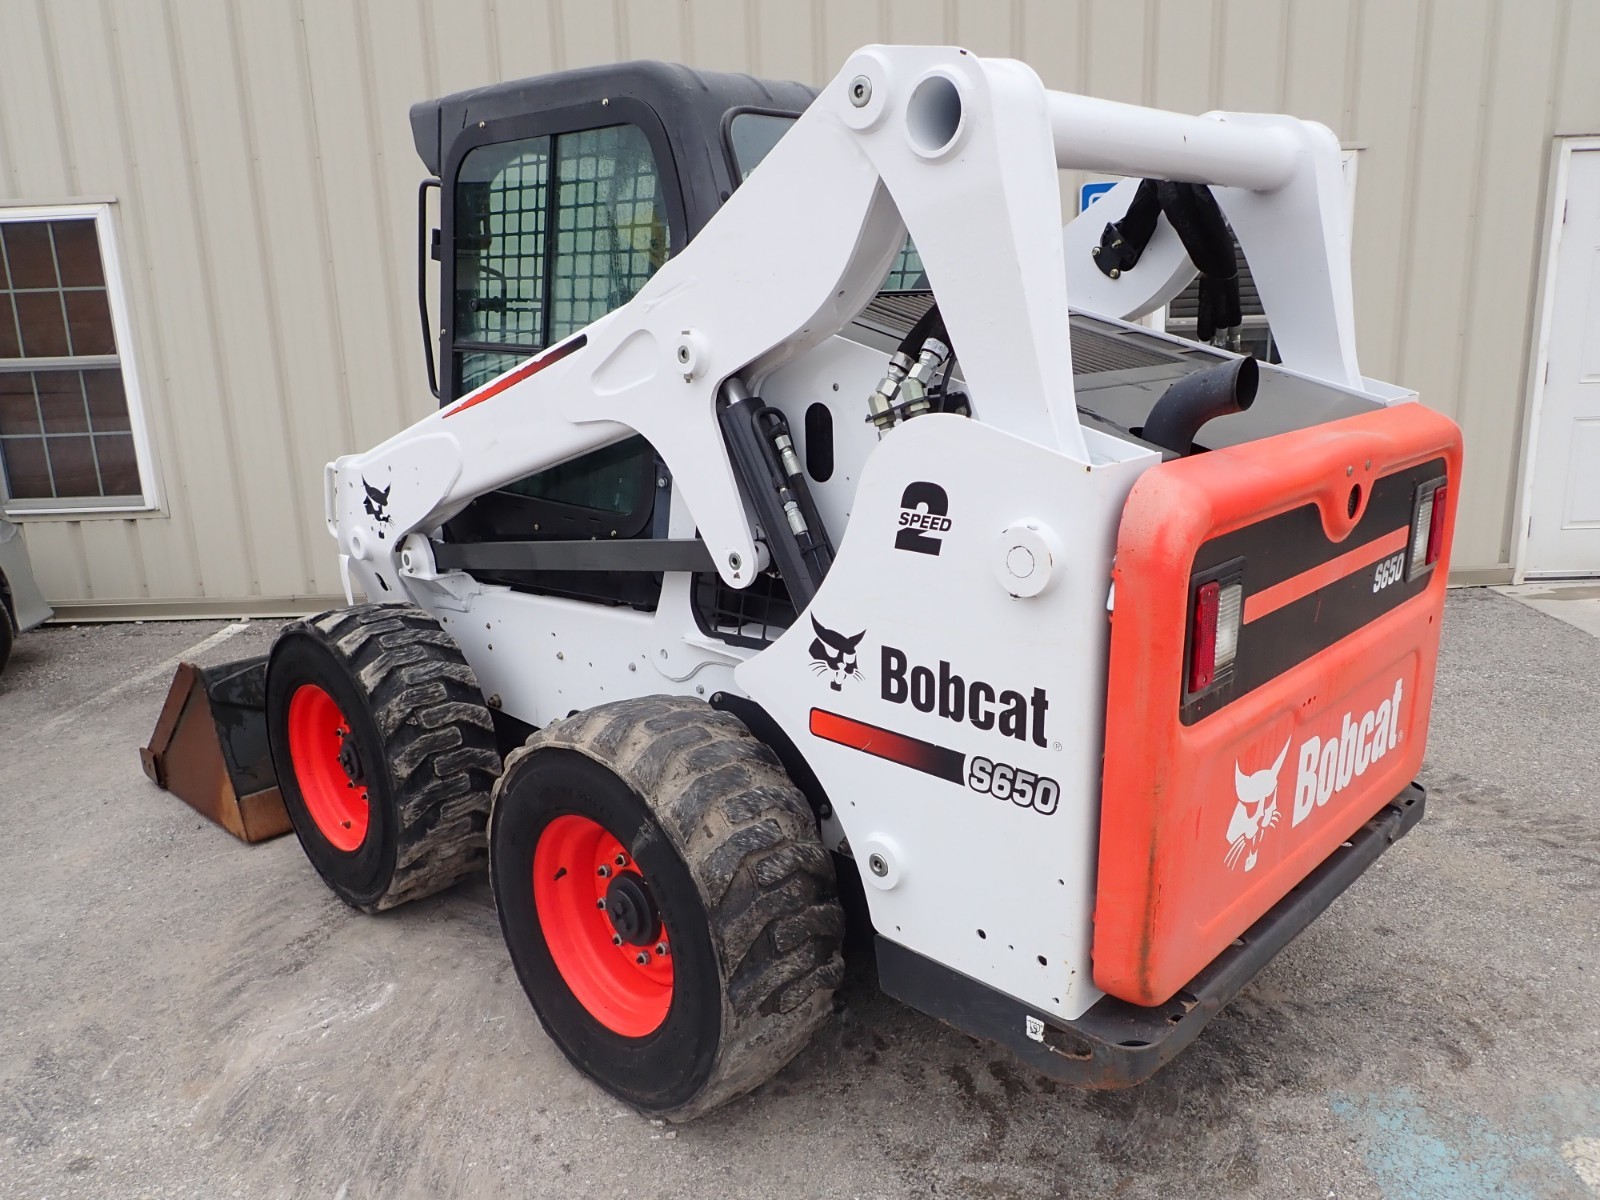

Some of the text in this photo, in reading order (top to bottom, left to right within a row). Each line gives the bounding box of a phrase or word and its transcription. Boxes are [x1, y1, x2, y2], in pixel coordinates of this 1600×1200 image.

[894, 481, 949, 557] 2
[898, 511, 953, 532] SPEED
[1372, 552, 1405, 594] S650
[881, 645, 1049, 748] Bobcat
[968, 755, 1061, 816] S650
[1291, 678, 1403, 829] Bobcat
